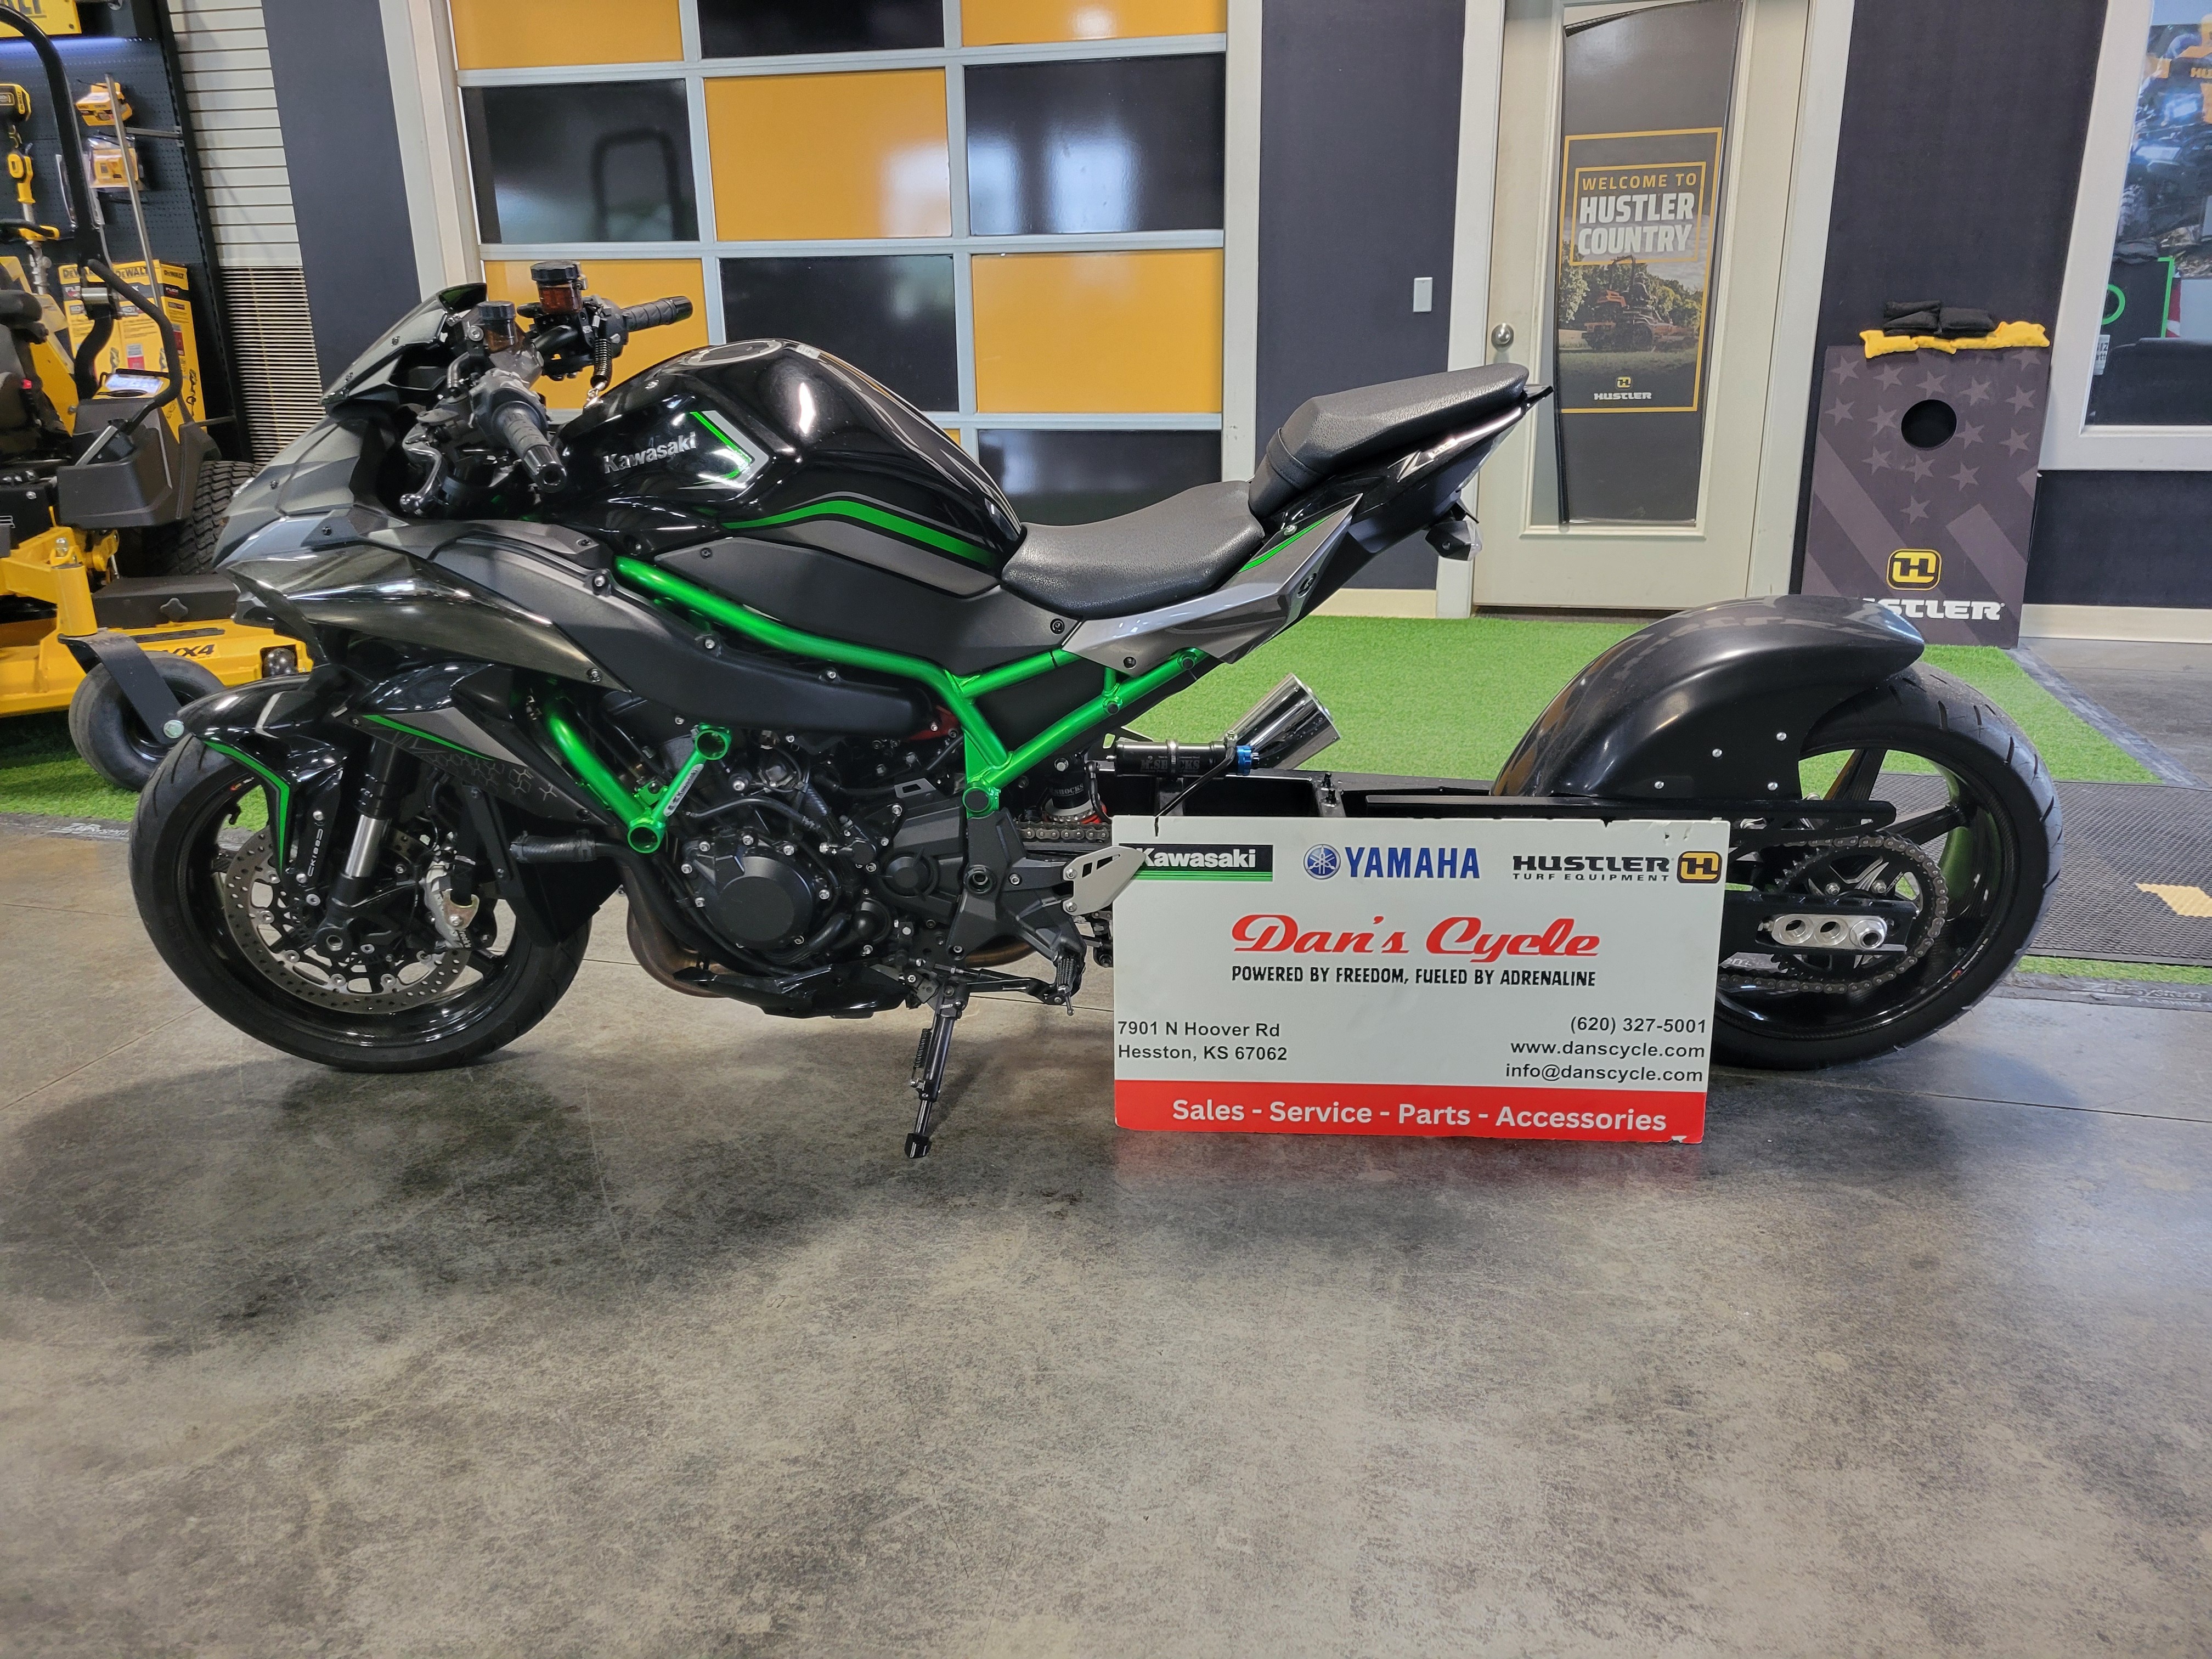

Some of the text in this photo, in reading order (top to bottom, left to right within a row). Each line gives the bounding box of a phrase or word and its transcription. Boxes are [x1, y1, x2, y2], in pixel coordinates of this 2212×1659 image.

[1582, 172, 1697, 191] WELCOME TO
[1579, 192, 1695, 224] HUSTLER
[1578, 224, 1693, 255] COUNTRY
[1593, 392, 1652, 401] HUSTLER
[603, 431, 697, 474] Kawasaki
[1862, 597, 2001, 620] STLER
[1136, 847, 1256, 868] Kawasaki
[1345, 847, 1480, 879] YAMAHA
[1512, 855, 1669, 871] HUSTLER
[1564, 873, 1669, 882] EQUIPMENT
[1232, 914, 1600, 963] Dan's Cycle
[1232, 966, 1596, 986] POWERED BY FREEDOM, FUELED BY ADRENALINE
[1118, 1021, 1279, 1037] 7901 N Hoover Rd
[1571, 1016, 1706, 1035] (620) 327-5001
[1119, 1044, 1287, 1062] Hesston, KS 67062
[1510, 1041, 1705, 1059] www.danscycle.com
[1506, 1063, 1702, 1084] info@danscycle.com
[1172, 1099, 1245, 1121] Sales
[1269, 1101, 1372, 1123] Service
[1399, 1103, 1470, 1125] Parts
[1495, 1106, 1666, 1131] Accessories
